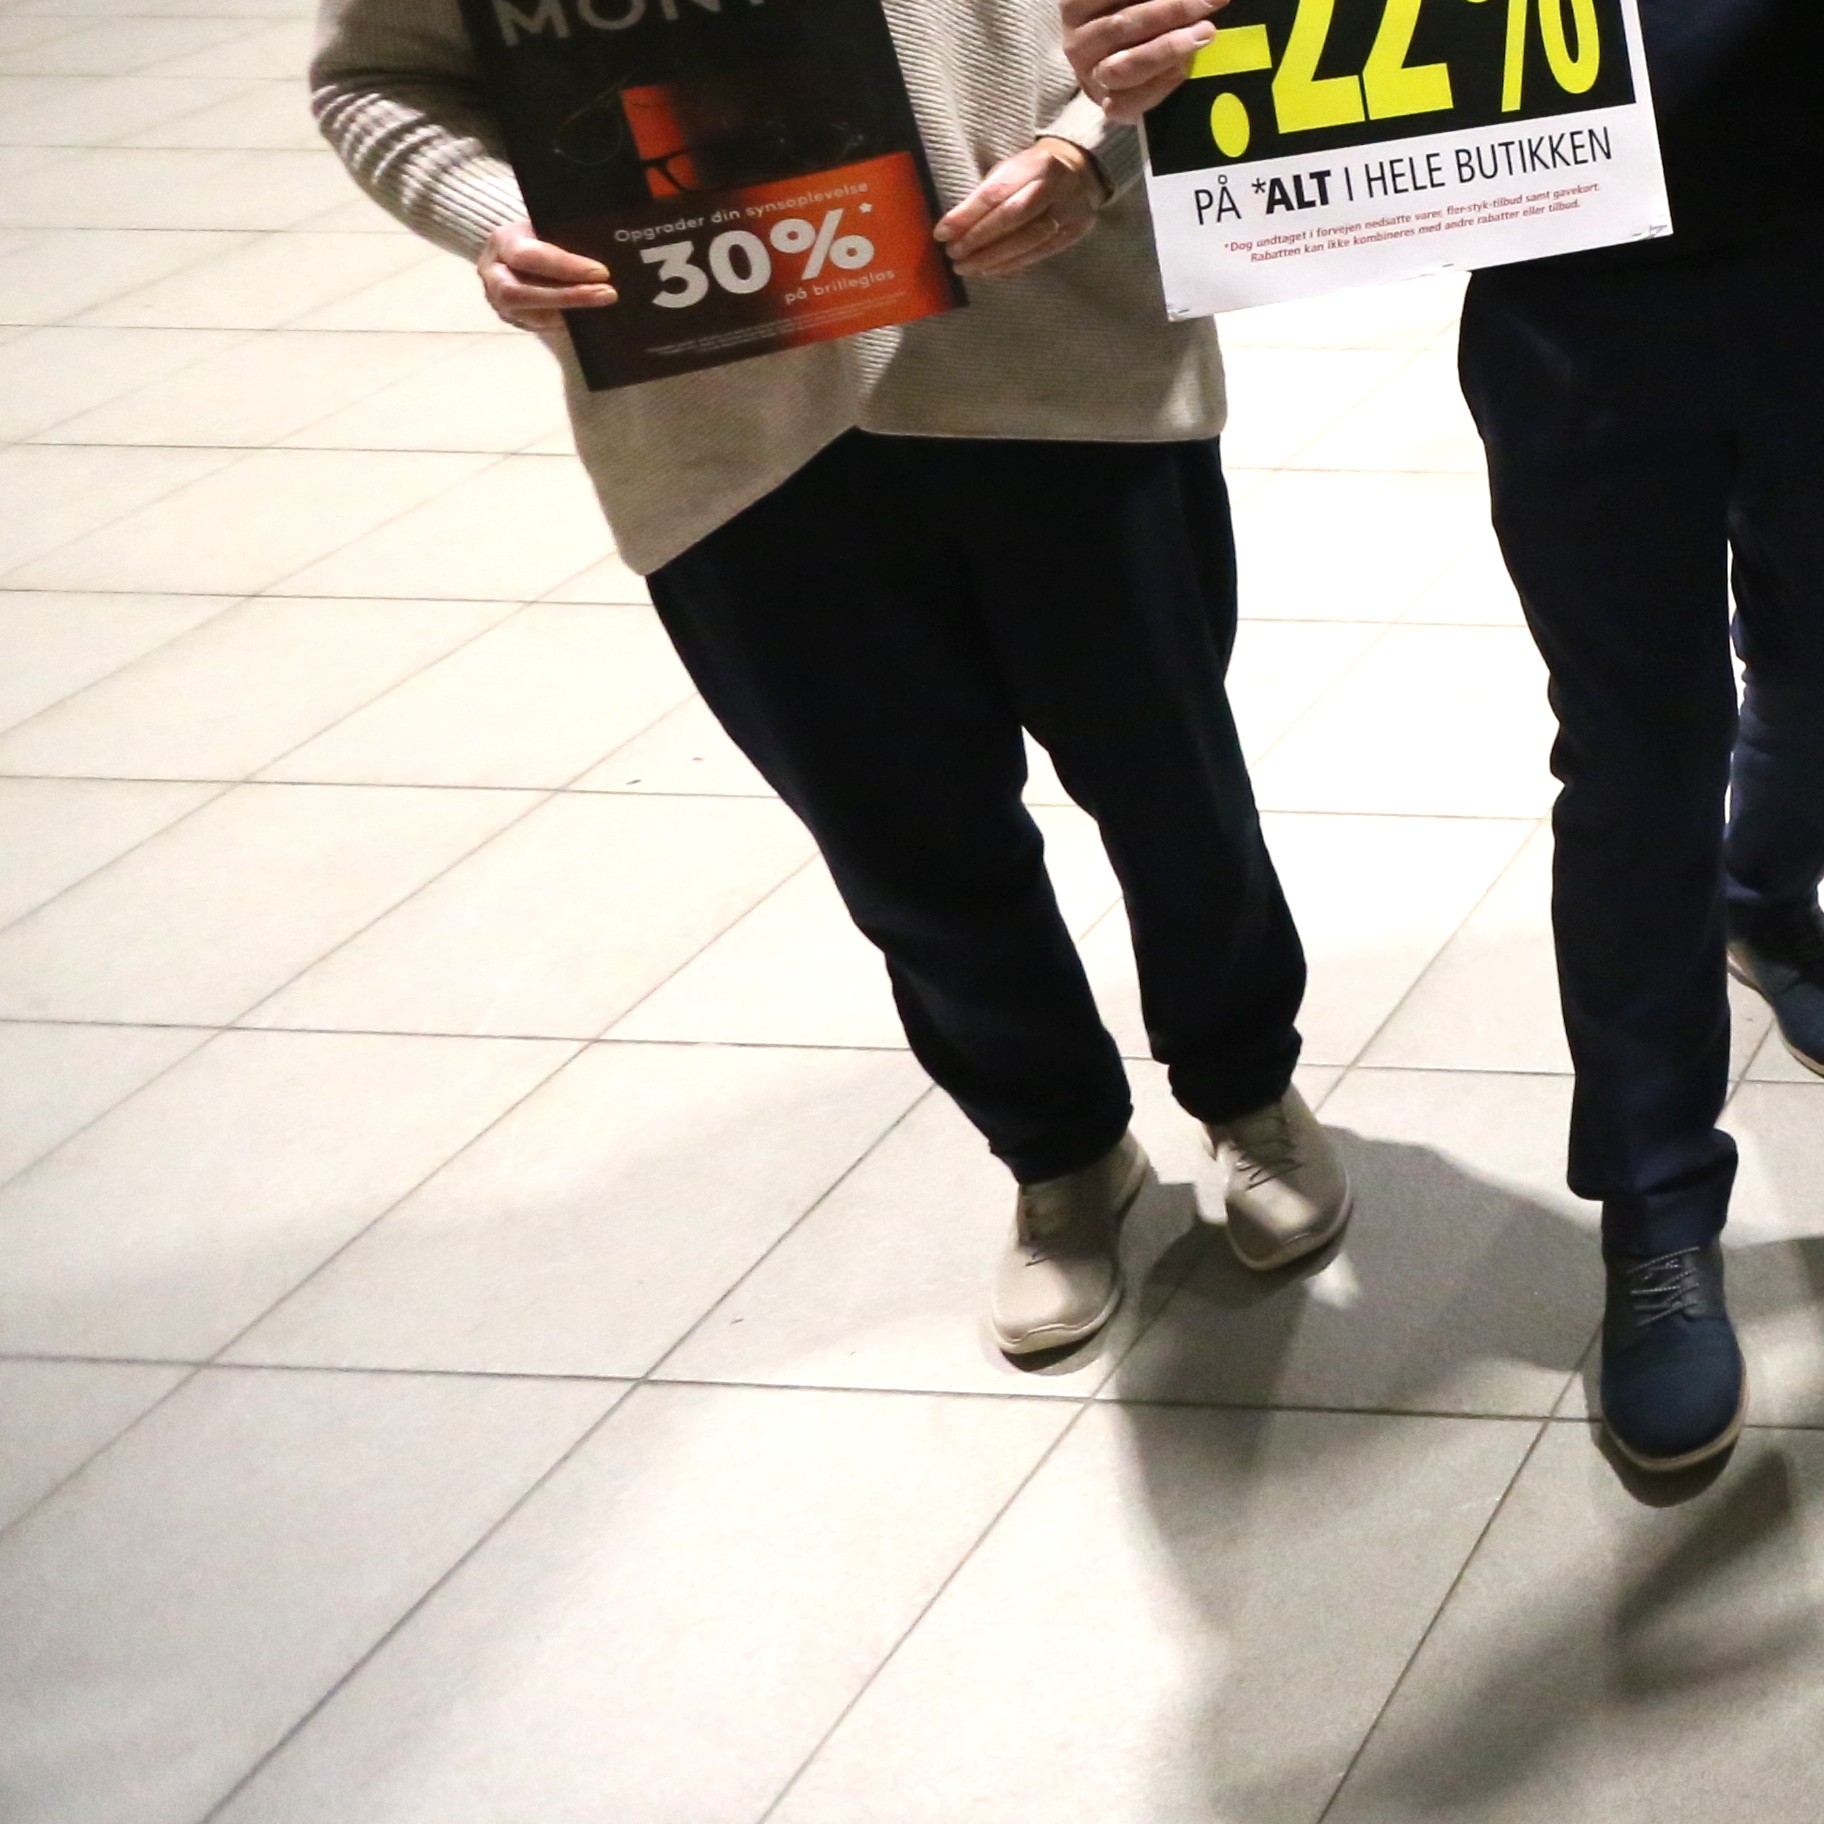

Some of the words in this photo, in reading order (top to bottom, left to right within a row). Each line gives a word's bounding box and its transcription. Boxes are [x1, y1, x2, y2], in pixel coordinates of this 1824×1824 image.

[1194, 173, 1242, 225] PÅ
[1345, 167, 1354, 201] I
[1366, 152, 1444, 196] HELE
[1455, 125, 1613, 184] BUTIKKEN
[614, 215, 706, 243] Opgrader
[711, 205, 741, 224] din
[745, 181, 869, 217] synsoplevelse
[1250, 246, 1301, 263] Rabatten
[1304, 242, 1324, 254] kan
[1327, 236, 1350, 250] ikke
[1353, 227, 1416, 246] kombineres
[1419, 222, 1442, 235] med
[1445, 217, 1475, 232] andre
[1477, 209, 1519, 226] rabatter
[1522, 204, 1545, 218] eller
[1548, 198, 1581, 213] tilbud.
[1316, 220, 1362, 240] forvejen
[1364, 212, 1412, 231] nedsatte
[1525, 188, 1550, 203] samt
[784, 286, 808, 305] på
[815, 267, 896, 297] brilleglas
